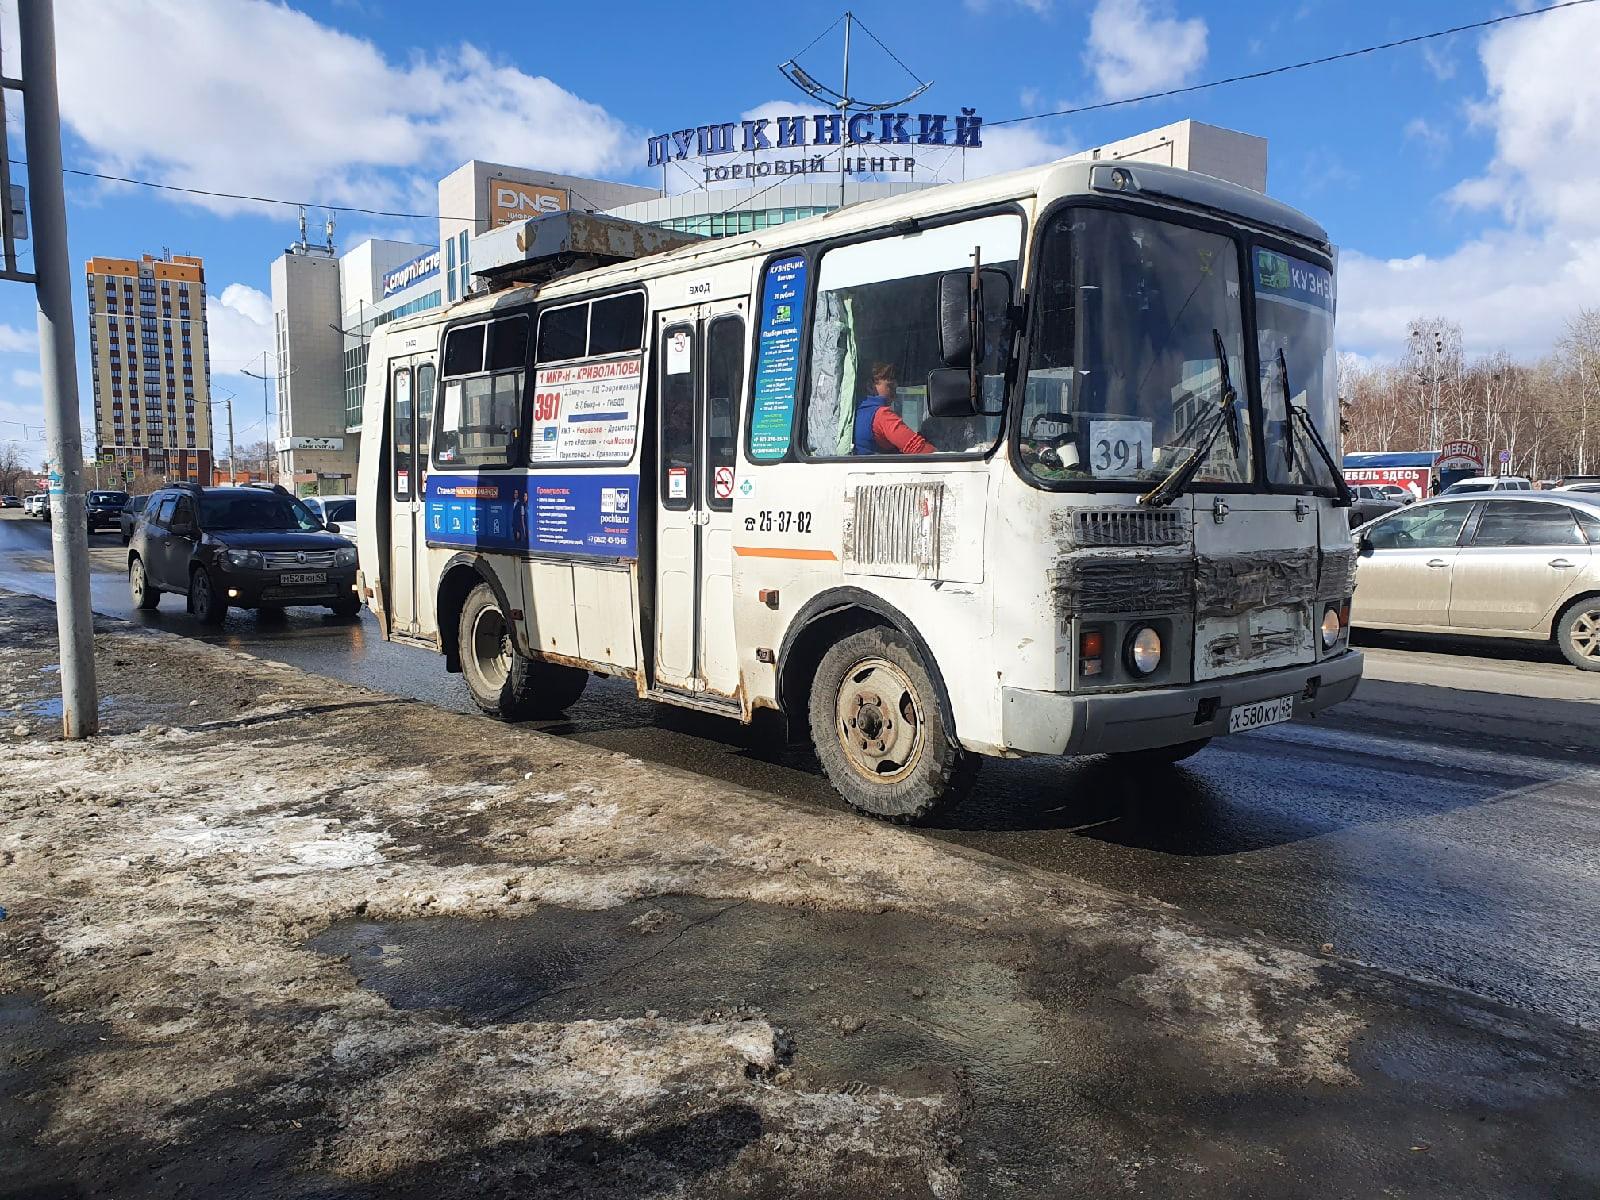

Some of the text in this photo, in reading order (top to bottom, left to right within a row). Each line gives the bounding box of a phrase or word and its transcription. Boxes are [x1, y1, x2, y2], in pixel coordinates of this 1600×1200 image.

[648, 107, 982, 167] ПУШКИНСКИЙ
[703, 155, 916, 182] ТОРГОВЫЙ ЦЕНТР
[497, 188, 561, 213] DNS
[534, 393, 561, 421] 391
[1096, 439, 1145, 471] 391
[1443, 443, 1478, 458] МЕБЕЛЬ
[1382, 471, 1420, 481] ЗДЕСЬ
[759, 510, 812, 533] 25-37-82
[1233, 705, 1278, 729] Х580КУ
